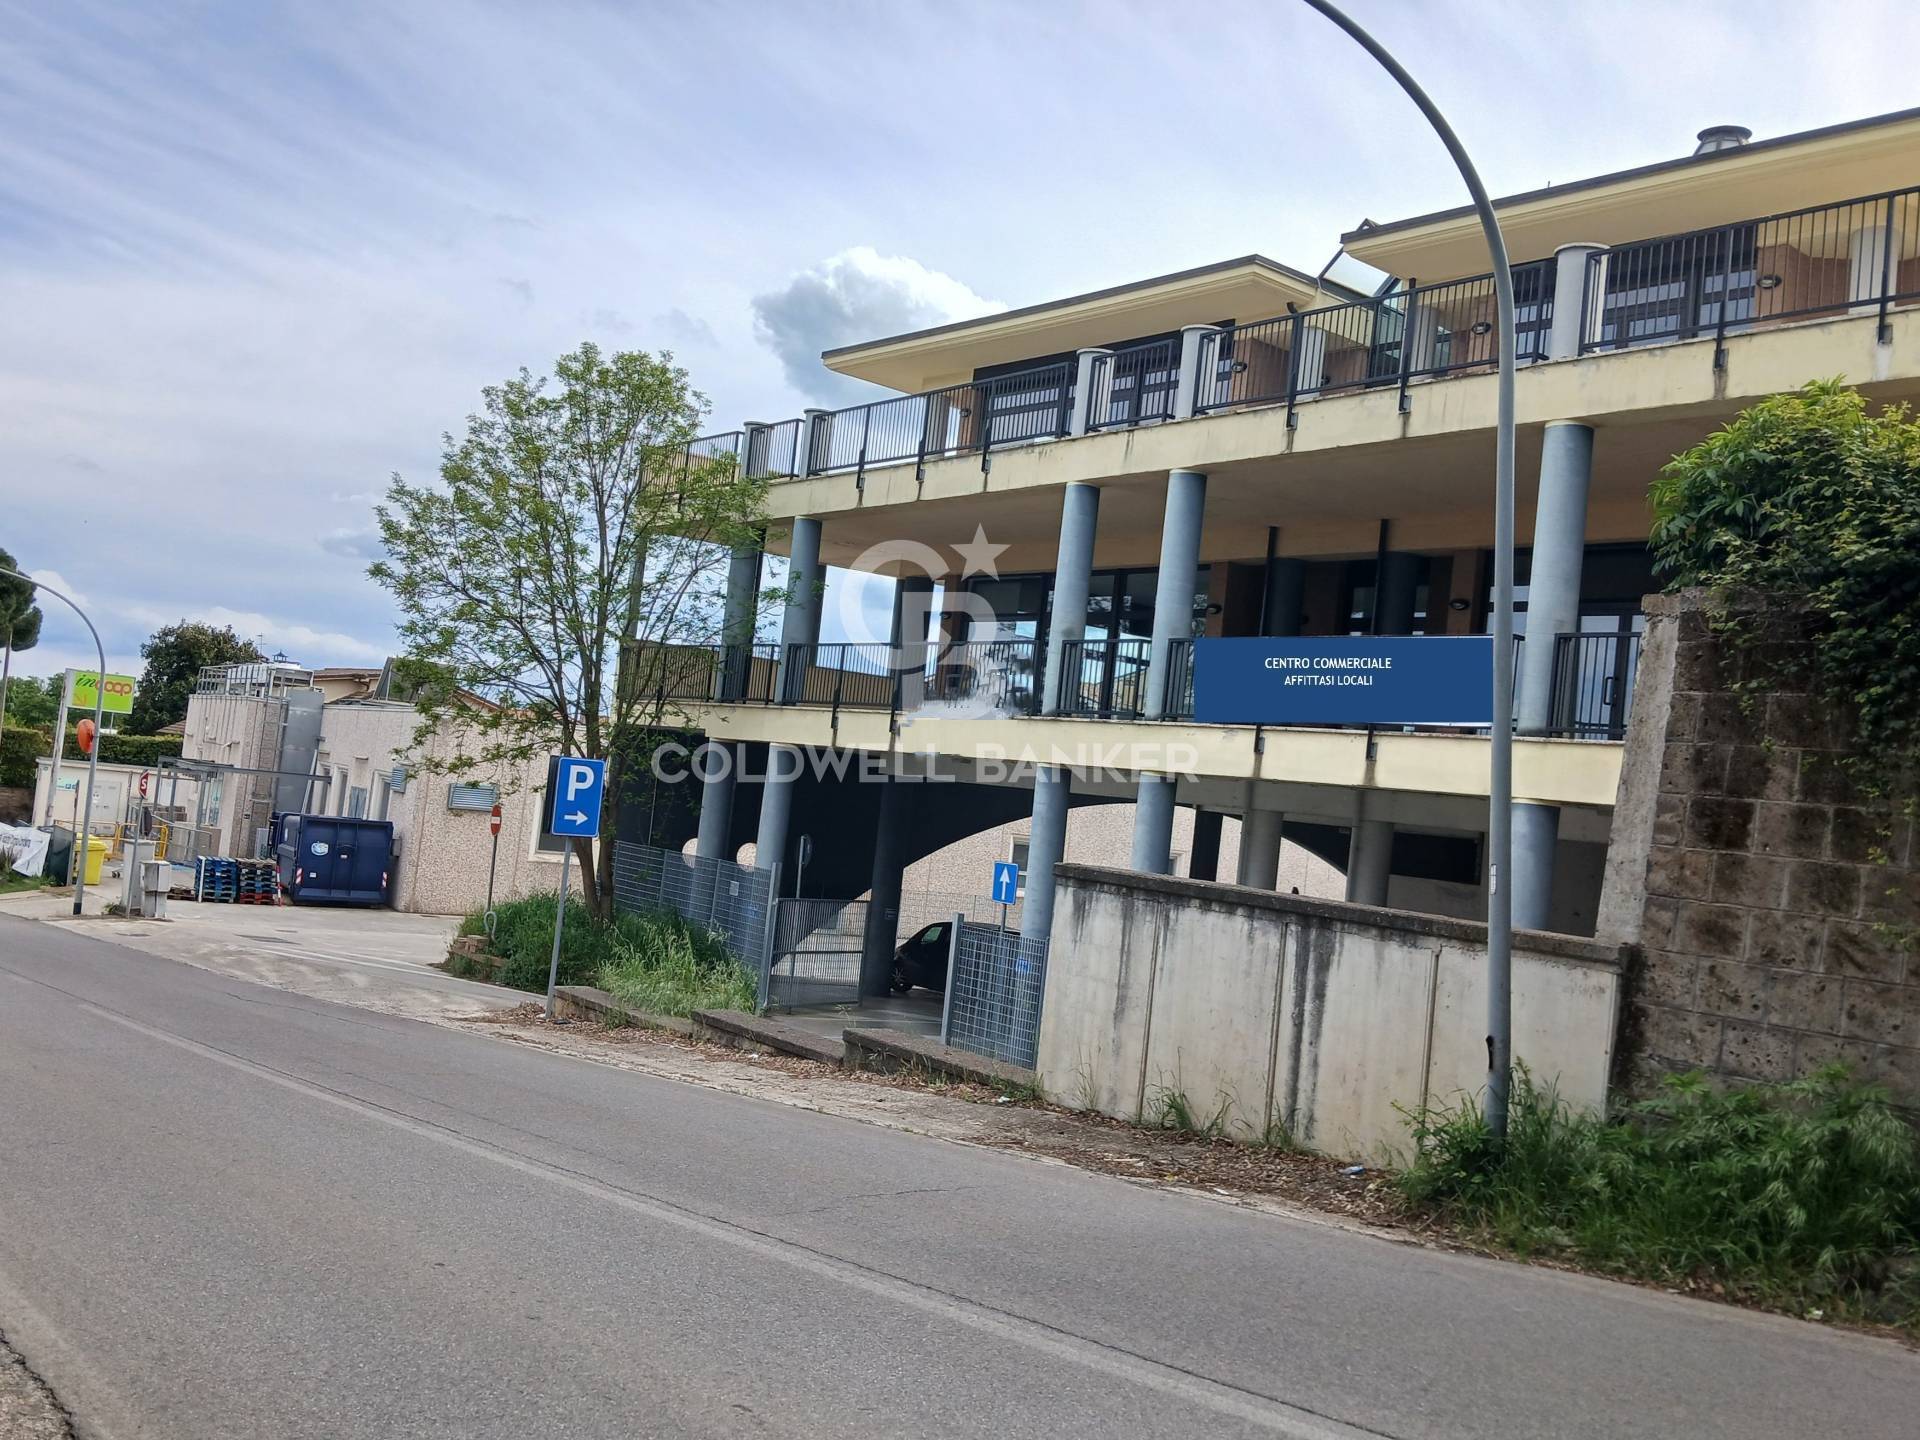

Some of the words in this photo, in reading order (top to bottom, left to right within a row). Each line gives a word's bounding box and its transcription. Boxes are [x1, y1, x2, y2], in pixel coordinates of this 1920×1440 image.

[1264, 657, 1310, 669] CENTRO
[1313, 657, 1392, 669] COMMERCIALE
[1284, 675, 1335, 686] AFFITTASI
[1337, 675, 1373, 686] LOCALI
[566, 764, 595, 801] P
